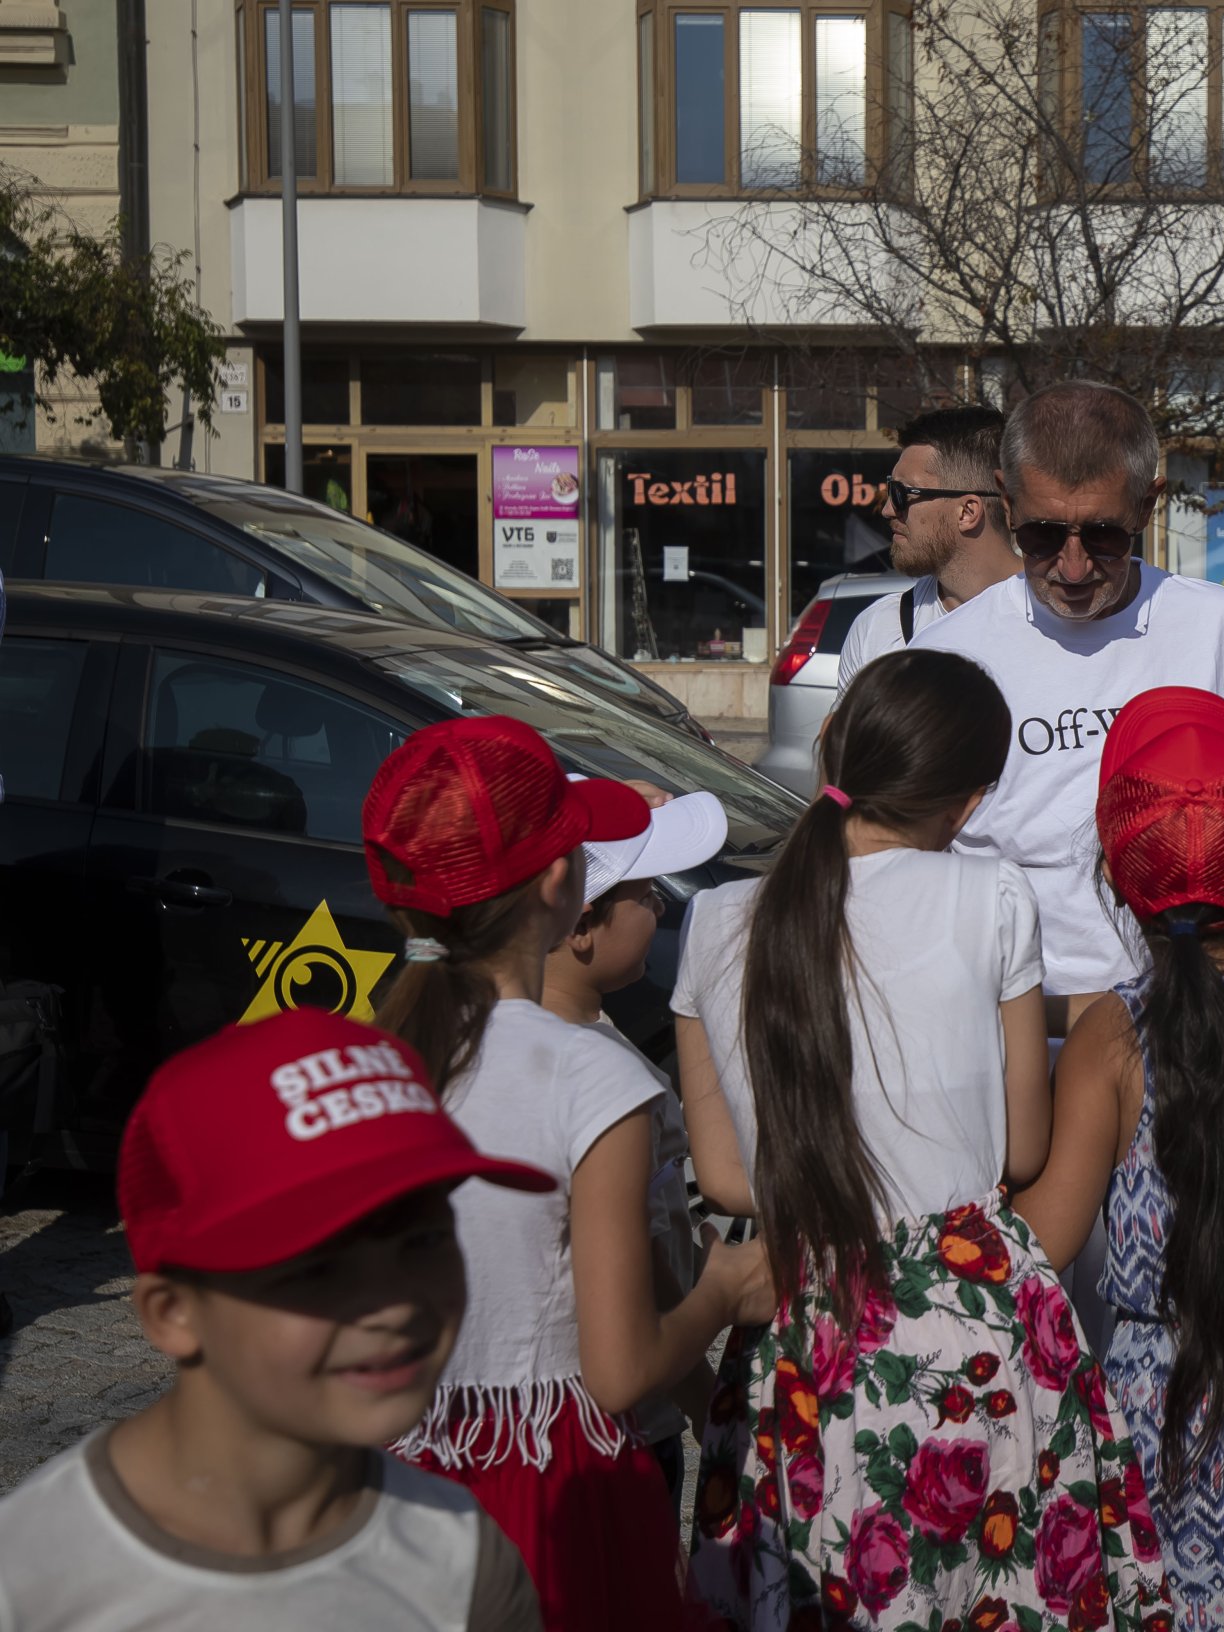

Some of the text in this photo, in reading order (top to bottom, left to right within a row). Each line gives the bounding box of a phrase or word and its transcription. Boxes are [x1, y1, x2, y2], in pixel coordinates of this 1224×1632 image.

[229, 395, 241, 408] 15
[627, 473, 736, 504] Textil
[821, 473, 887, 506] Ob
[270, 1041, 413, 1097] SILNÉ
[285, 1078, 437, 1141] ČESKO
